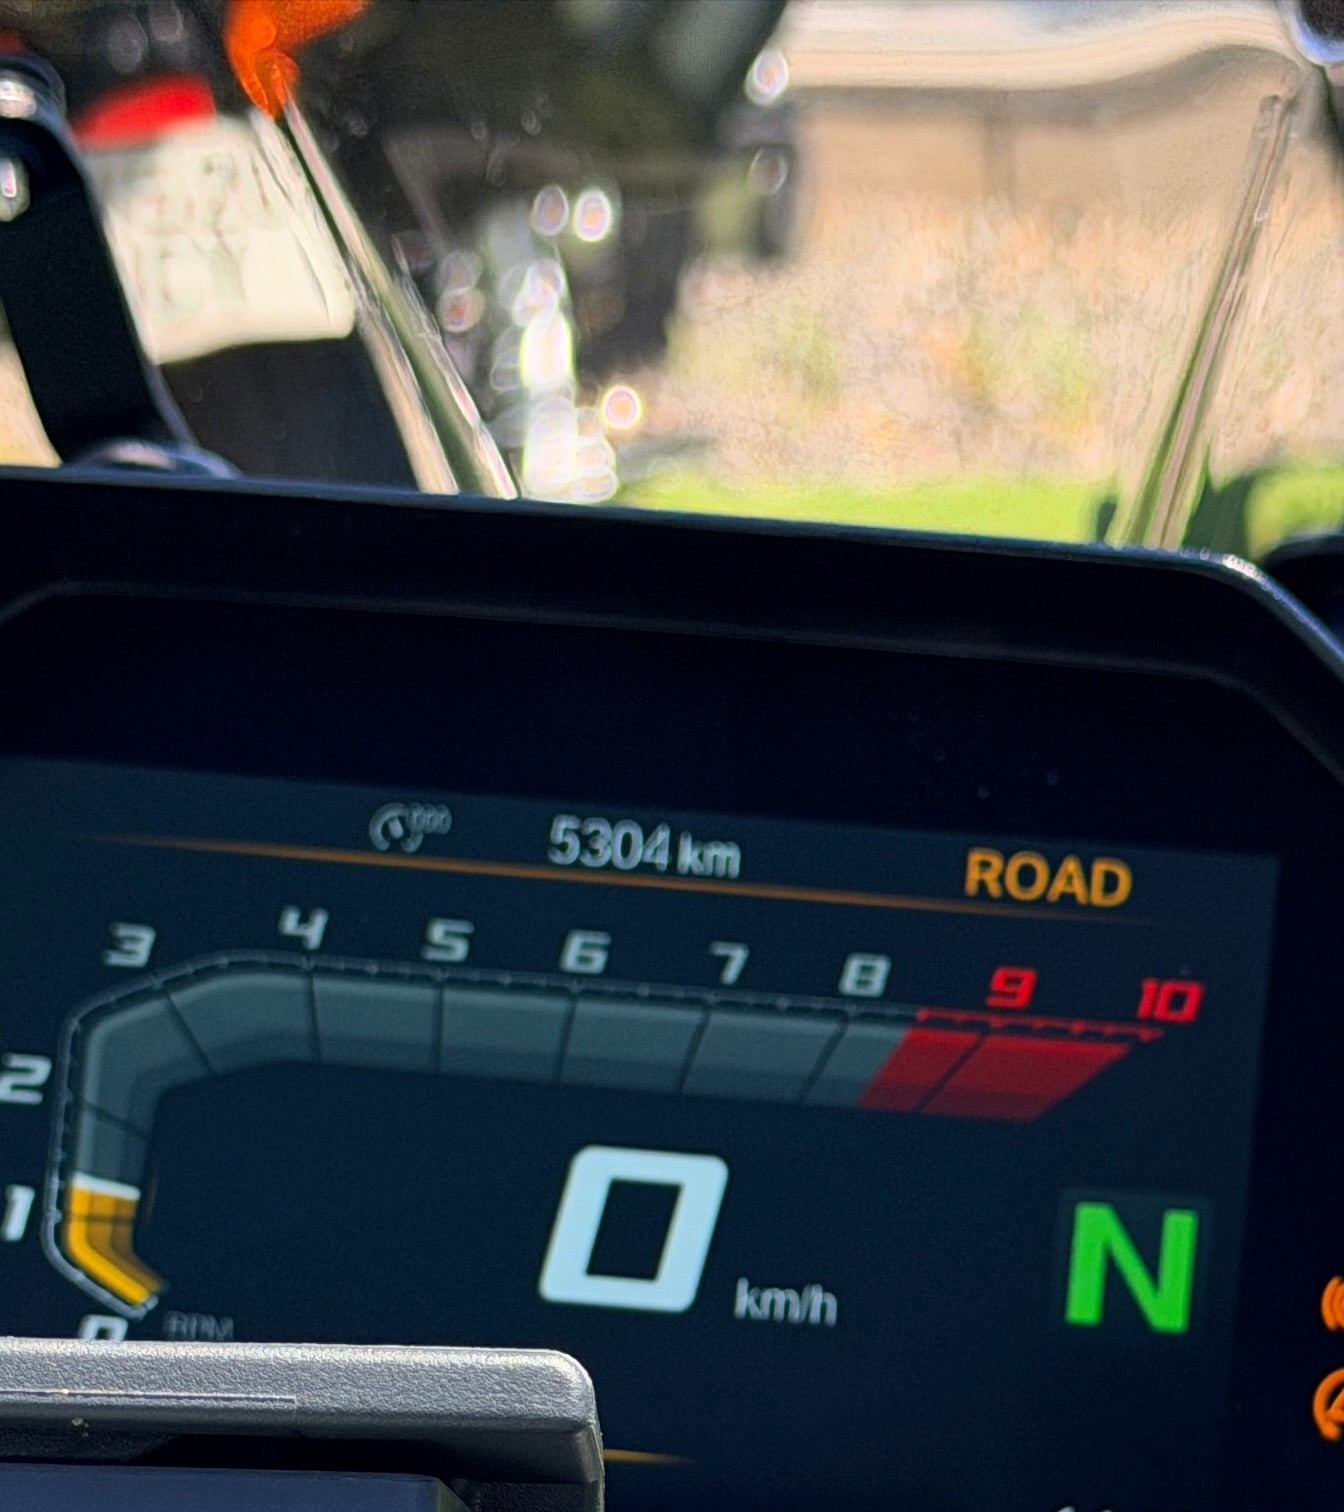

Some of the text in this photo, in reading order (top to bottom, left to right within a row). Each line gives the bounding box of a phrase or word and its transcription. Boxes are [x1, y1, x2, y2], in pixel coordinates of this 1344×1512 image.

[548, 814, 742, 879] 5304 km
[964, 849, 1133, 907] ROAD
[104, 906, 1205, 1023] 3 4 5 6 7 8 9 10
[1, 1183, 36, 1242] 1
[539, 1145, 839, 1327] 0 km/h
[1065, 1202, 1200, 1334] N
